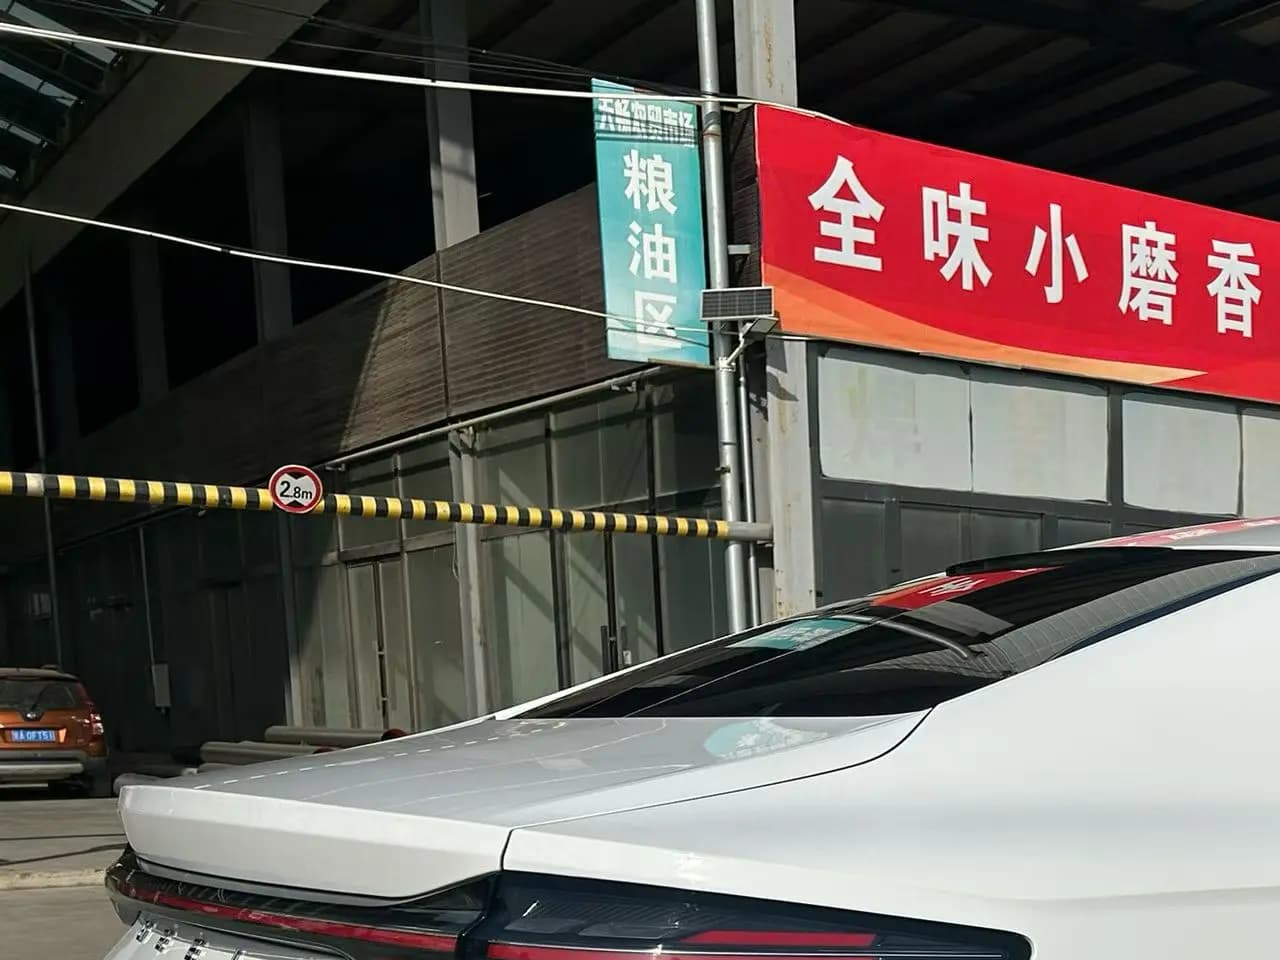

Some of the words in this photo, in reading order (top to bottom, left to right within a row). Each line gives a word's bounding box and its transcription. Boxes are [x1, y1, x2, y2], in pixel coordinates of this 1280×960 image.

[623, 149, 681, 349] 粮油区
[279, 480, 313, 500] 2.8m
